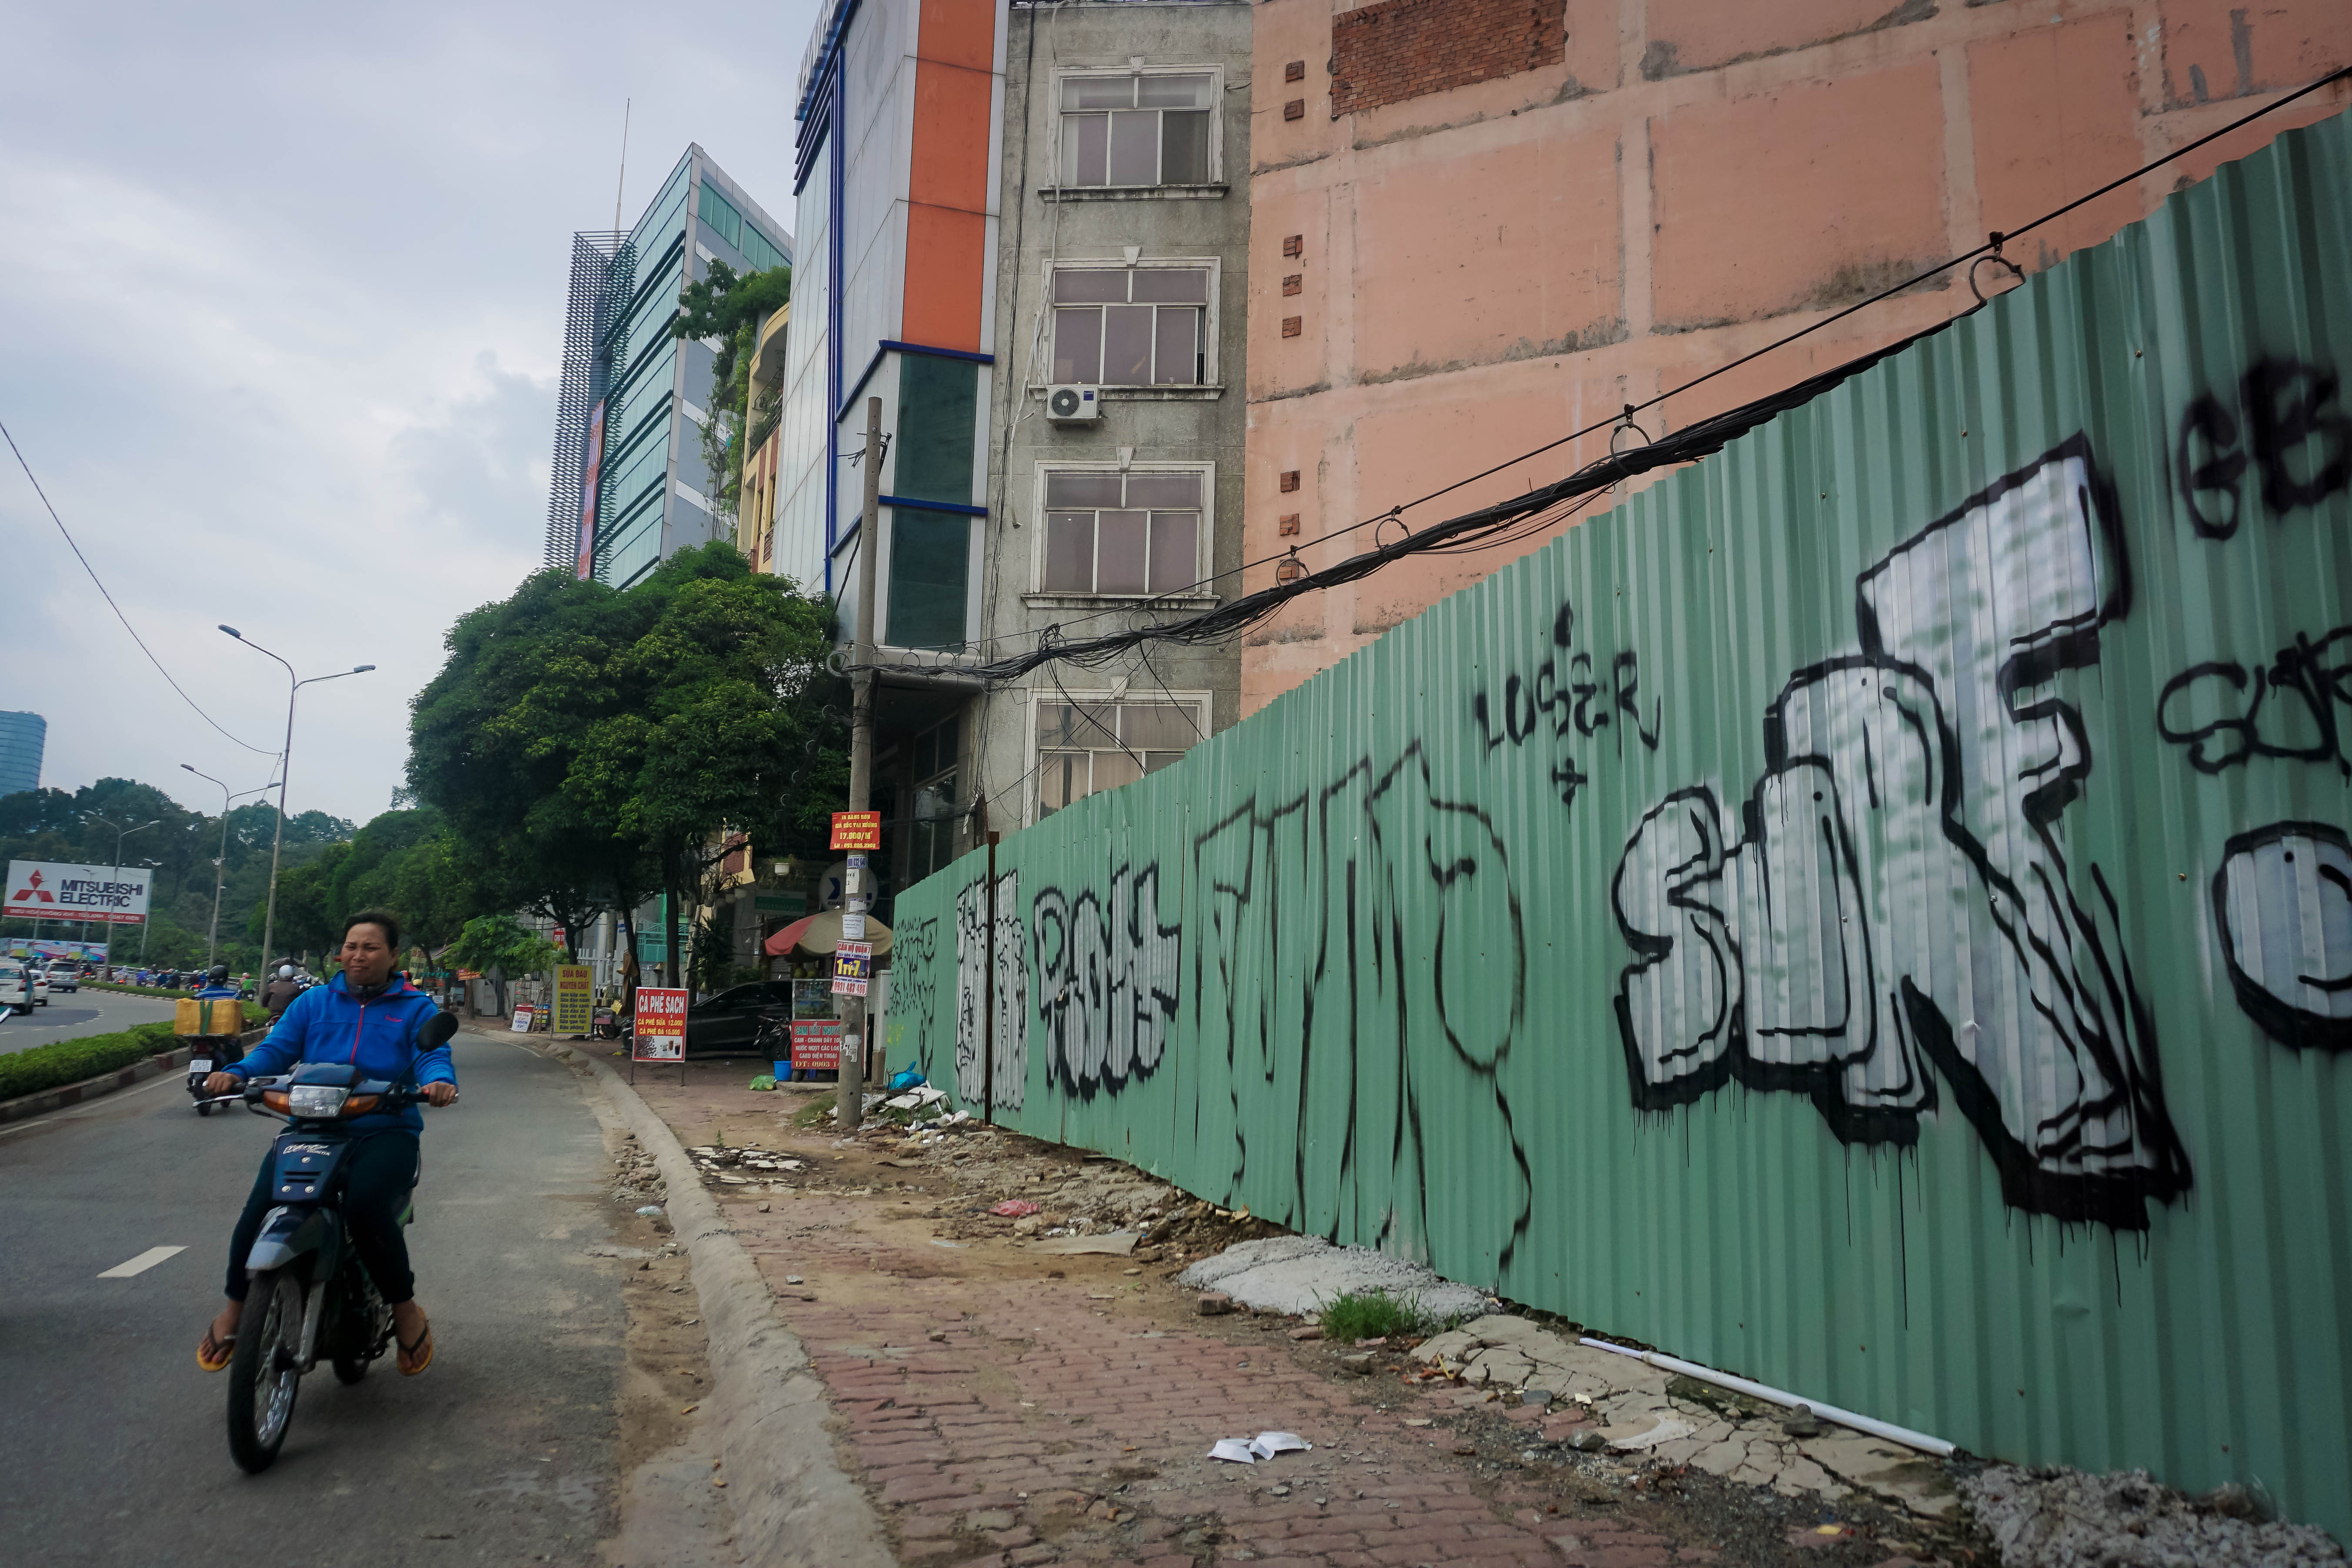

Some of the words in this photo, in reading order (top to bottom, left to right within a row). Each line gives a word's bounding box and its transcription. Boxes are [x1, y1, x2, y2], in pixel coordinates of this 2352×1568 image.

[61, 879, 143, 895] MITSUBISHI
[60, 891, 130, 907] ELECTRIC
[650, 991, 664, 1013] PHÊ
[665, 995, 685, 1019] SẠCH
[794, 1025, 808, 1035] CAM
